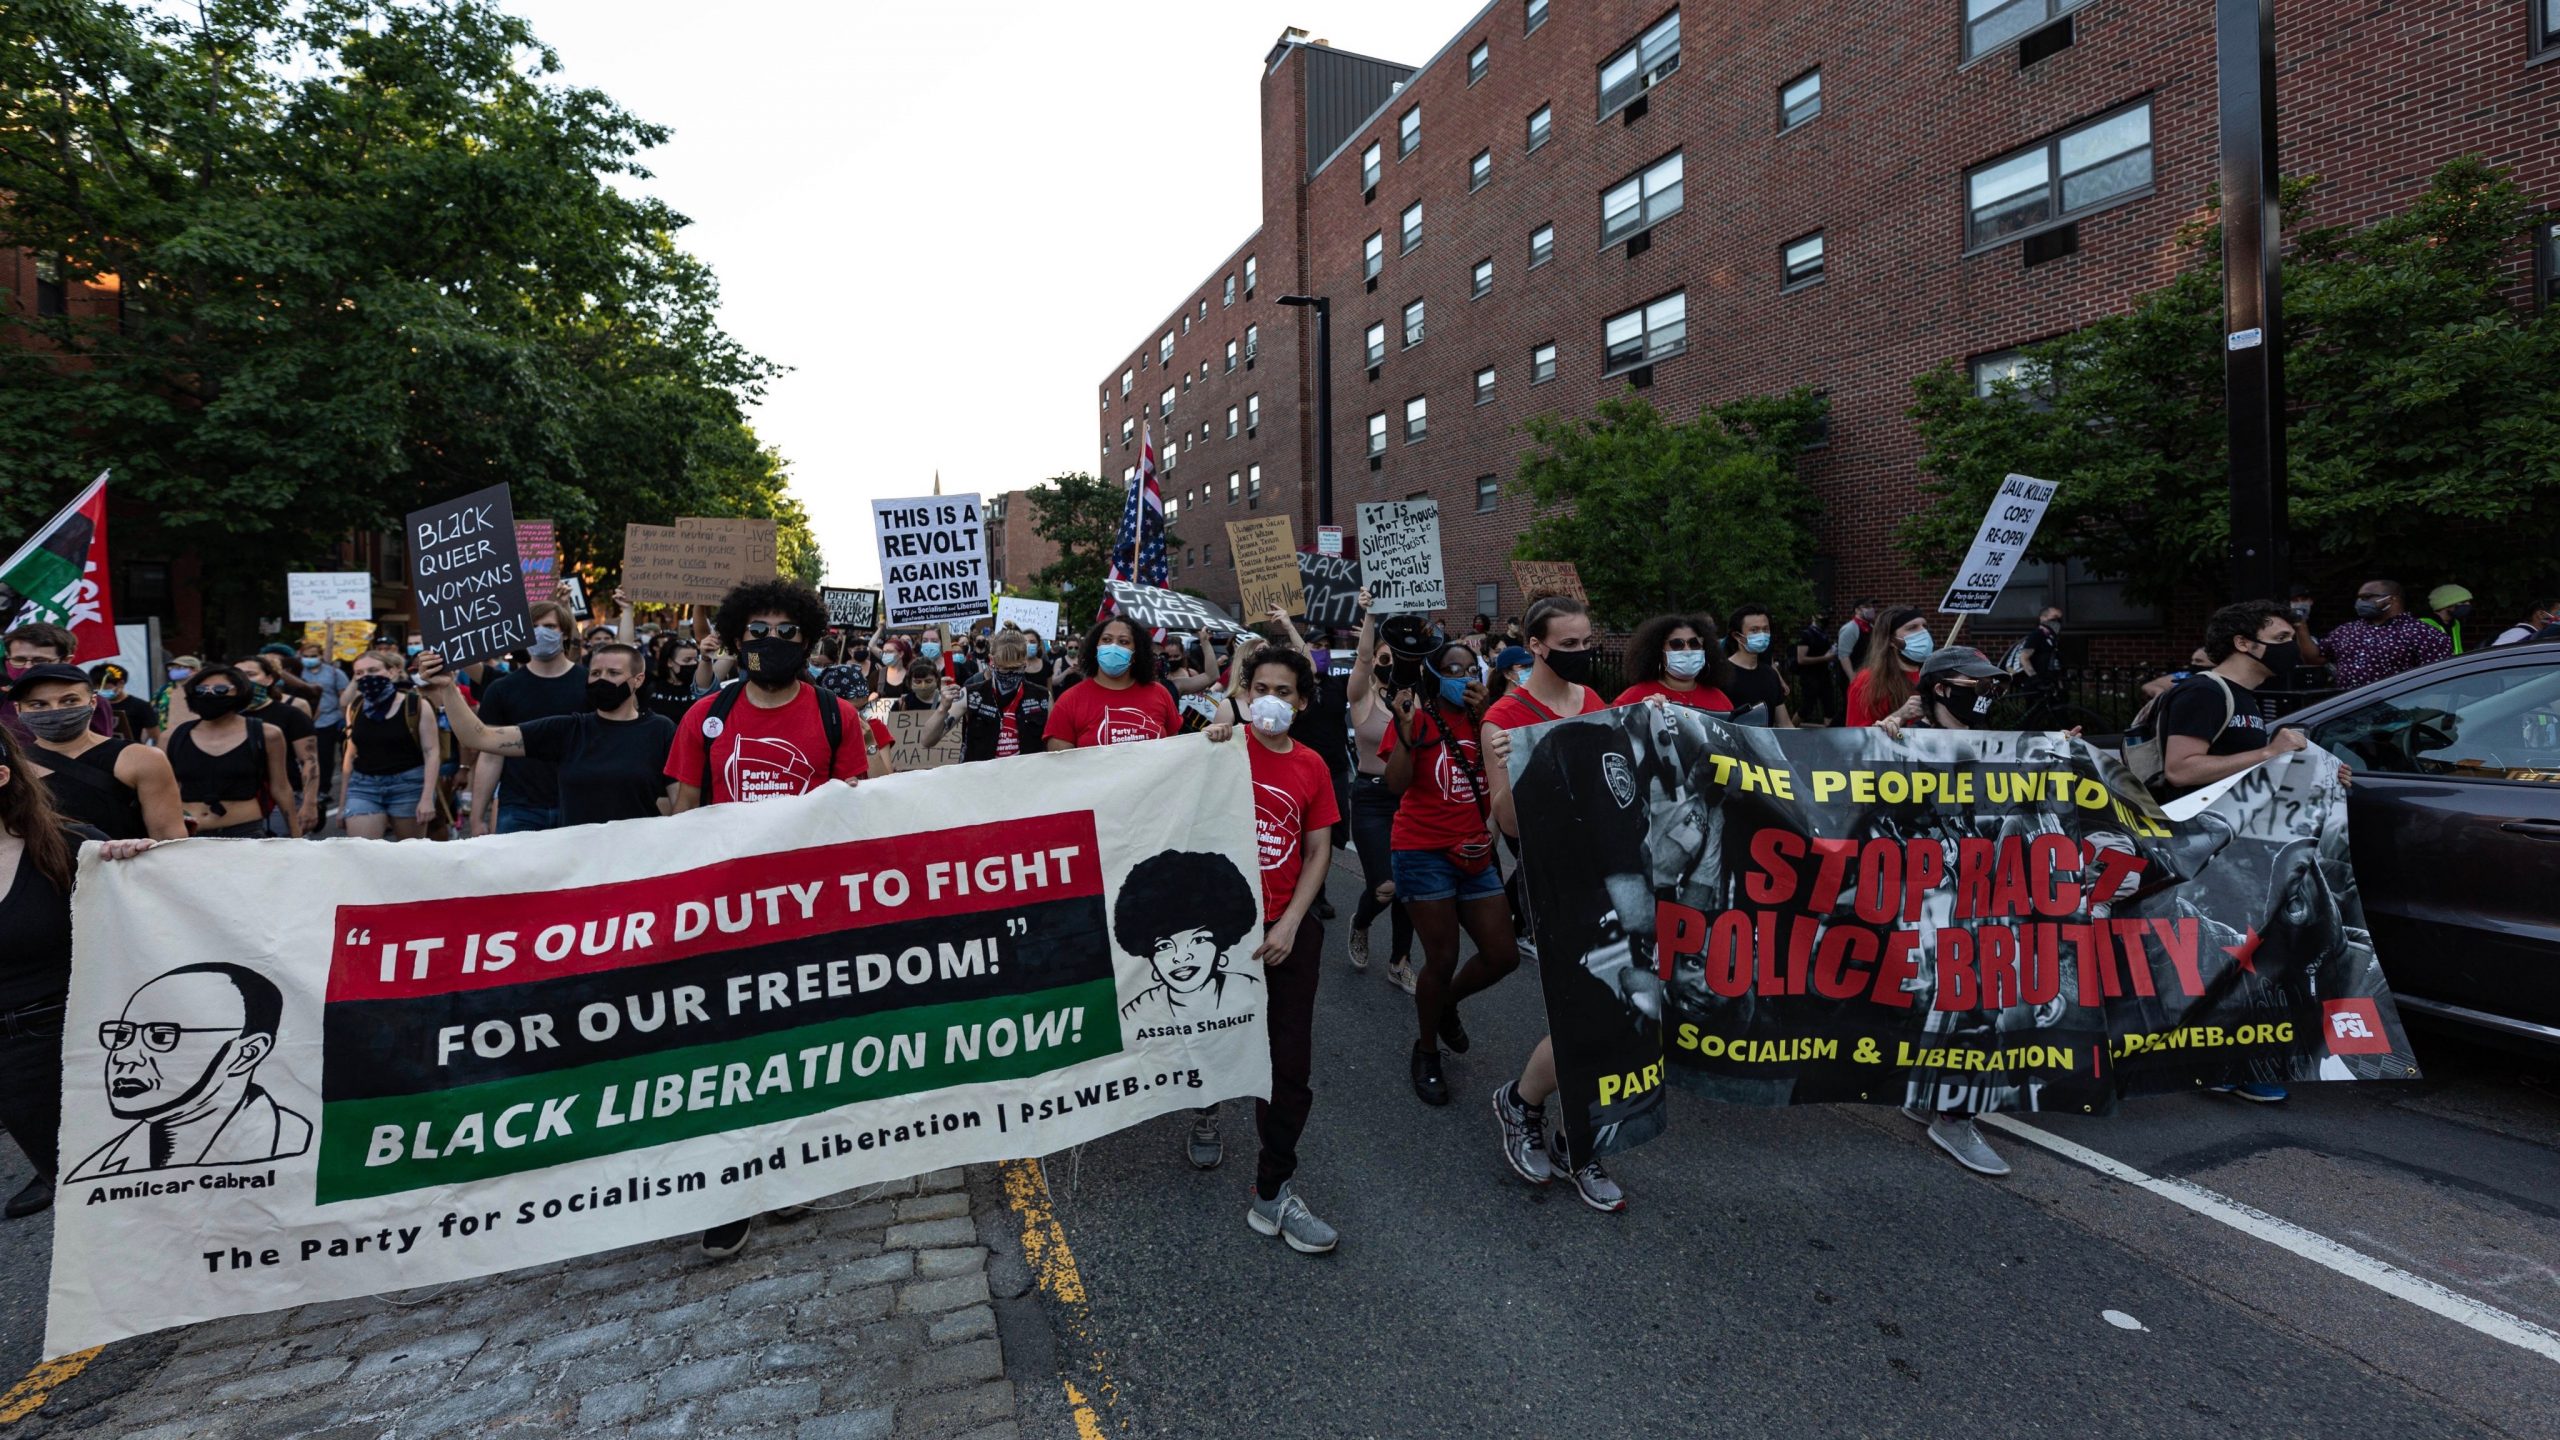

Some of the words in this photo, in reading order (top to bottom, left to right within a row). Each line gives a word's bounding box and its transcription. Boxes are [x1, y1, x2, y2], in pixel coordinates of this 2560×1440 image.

[2002, 480, 2025, 497] JAIL
[2023, 484, 2053, 503] KILLER
[879, 508, 930, 529] THIS
[936, 506, 956, 525] IS
[963, 504, 978, 523] A
[1393, 503, 1408, 518] is
[2003, 505, 2035, 523] COPS!
[1420, 523, 1431, 533] be
[1985, 528, 2027, 546] RE-OPEN
[884, 528, 978, 558] REVOLT
[420, 540, 496, 575] QUEER
[1421, 551, 1432, 560] be
[1985, 552, 2006, 566] THE
[889, 559, 981, 584] AGAINST
[1967, 573, 2002, 588] CASES!
[418, 564, 513, 606] WOMXNS
[898, 580, 978, 604] RACISM
[1113, 582, 1202, 605] BLACK
[440, 595, 501, 631] LIVES
[892, 609, 910, 617] Party
[917, 605, 947, 613] Socialism
[957, 601, 987, 610] Liberation
[1114, 591, 1208, 616] LIVES
[833, 611, 873, 625] RACISM
[1128, 607, 1248, 634] MATTER
[1111, 728, 1131, 737] Party
[1111, 734, 1145, 743] Socialism
[892, 747, 961, 764] MATTE
[742, 770, 770, 782] Party
[772, 771, 780, 779] for
[742, 781, 788, 791] Socialism
[1709, 754, 1794, 800] THE
[1812, 770, 1974, 804] PEOPLE
[1257, 831, 1282, 845] ialism
[1258, 845, 1282, 857] ration
[1745, 828, 1944, 924] STOP
[461, 931, 517, 974] IS
[534, 907, 654, 963] OUR
[674, 879, 824, 941] DUTY
[839, 868, 911, 912] TO
[926, 846, 1081, 899] FIGHT
[1656, 901, 1919, 1008] POLICE
[437, 1019, 561, 1066] FOR
[578, 983, 711, 1043] OUR
[1136, 1020, 1192, 1041] Assata
[1196, 1012, 1255, 1035] Shakur
[2332, 1019, 2374, 1038] PSL
[1598, 1056, 1664, 1106] PART
[1676, 1023, 1838, 1063] SOCIALISM
[1852, 1037, 1882, 1064] &
[1896, 1042, 2074, 1071] LIBERATION
[364, 1093, 580, 1167] BLACK
[595, 1032, 927, 1129] LIBERATION
[944, 1006, 1085, 1066] NOW!
[199, 1170, 275, 1193] Cabral
[202, 1244, 280, 1274] The
[300, 1222, 421, 1263] Party
[437, 1209, 500, 1239] for
[515, 1169, 706, 1226] Socialism
[720, 1146, 787, 1186] and
[802, 1105, 981, 1165] Liberation
[1021, 1066, 1203, 1123] PSLWEB.org
